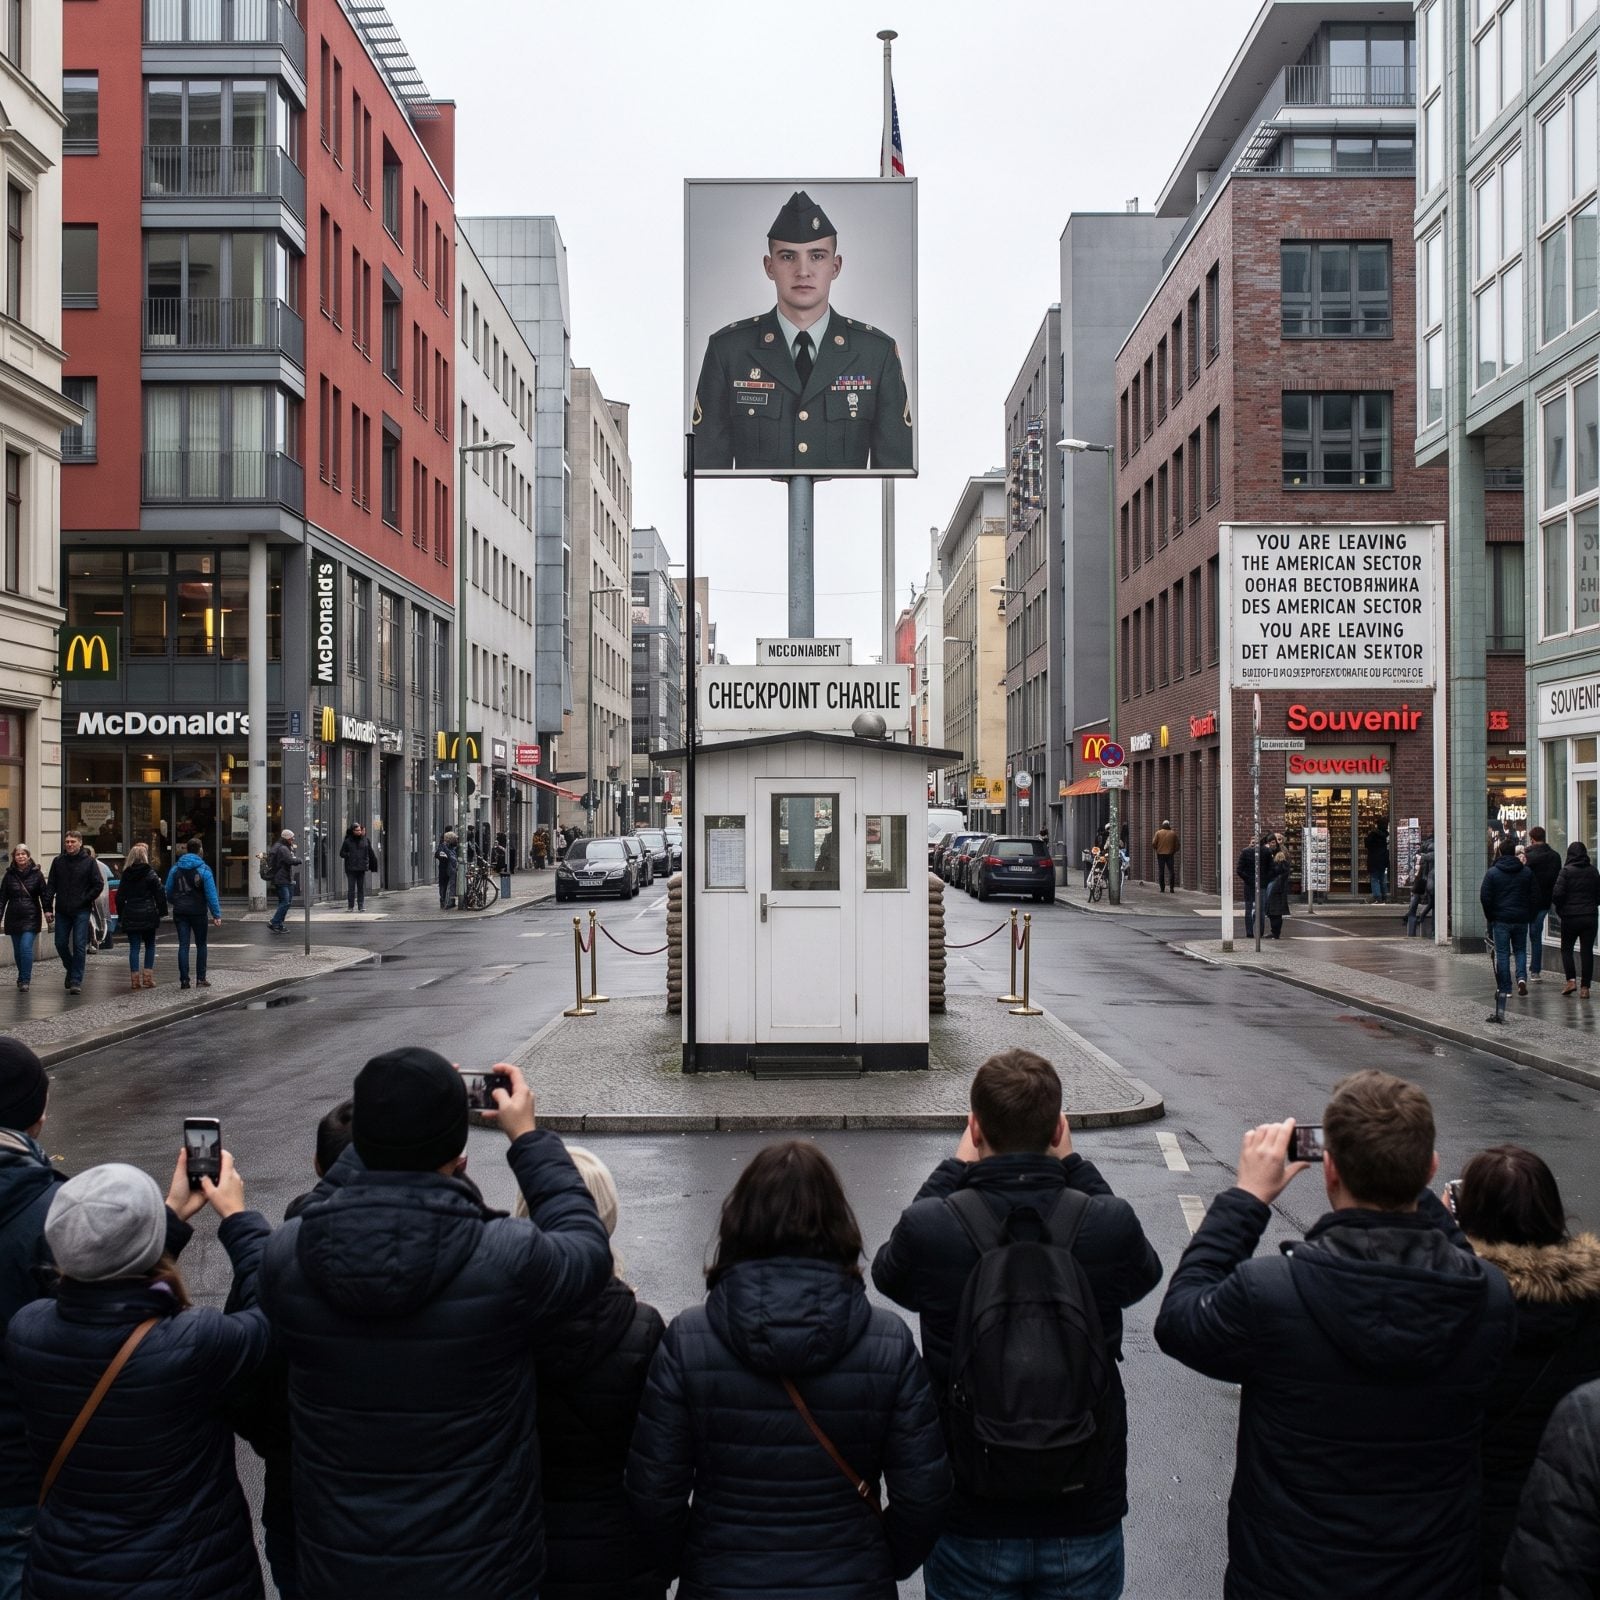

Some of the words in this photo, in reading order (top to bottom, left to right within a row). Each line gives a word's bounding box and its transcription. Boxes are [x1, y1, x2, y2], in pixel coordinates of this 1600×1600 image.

[1257, 534, 1290, 550] YOU
[1298, 534, 1330, 550] ARE
[1339, 534, 1407, 550] LEAVING
[1242, 555, 1269, 571] THE
[1276, 555, 1356, 571] AMERICAN
[1363, 555, 1422, 571] SECTOR
[1242, 598, 1271, 614] DES
[1277, 598, 1356, 614] AMERICAN
[1363, 598, 1422, 614] SECTOR
[317, 563, 333, 682] McDonald's
[1260, 622, 1292, 638] YOU
[1299, 622, 1331, 638] ARE
[1338, 622, 1404, 638] LEAVING
[1242, 644, 1268, 660] DET
[1276, 644, 1356, 660] AMERICAN
[1364, 644, 1423, 660] SEKTOR
[708, 682, 820, 709] CHECKPOINT
[826, 682, 900, 709] CHARLIE
[1287, 704, 1422, 731] Souvenir
[1289, 754, 1387, 774] Souvenir
